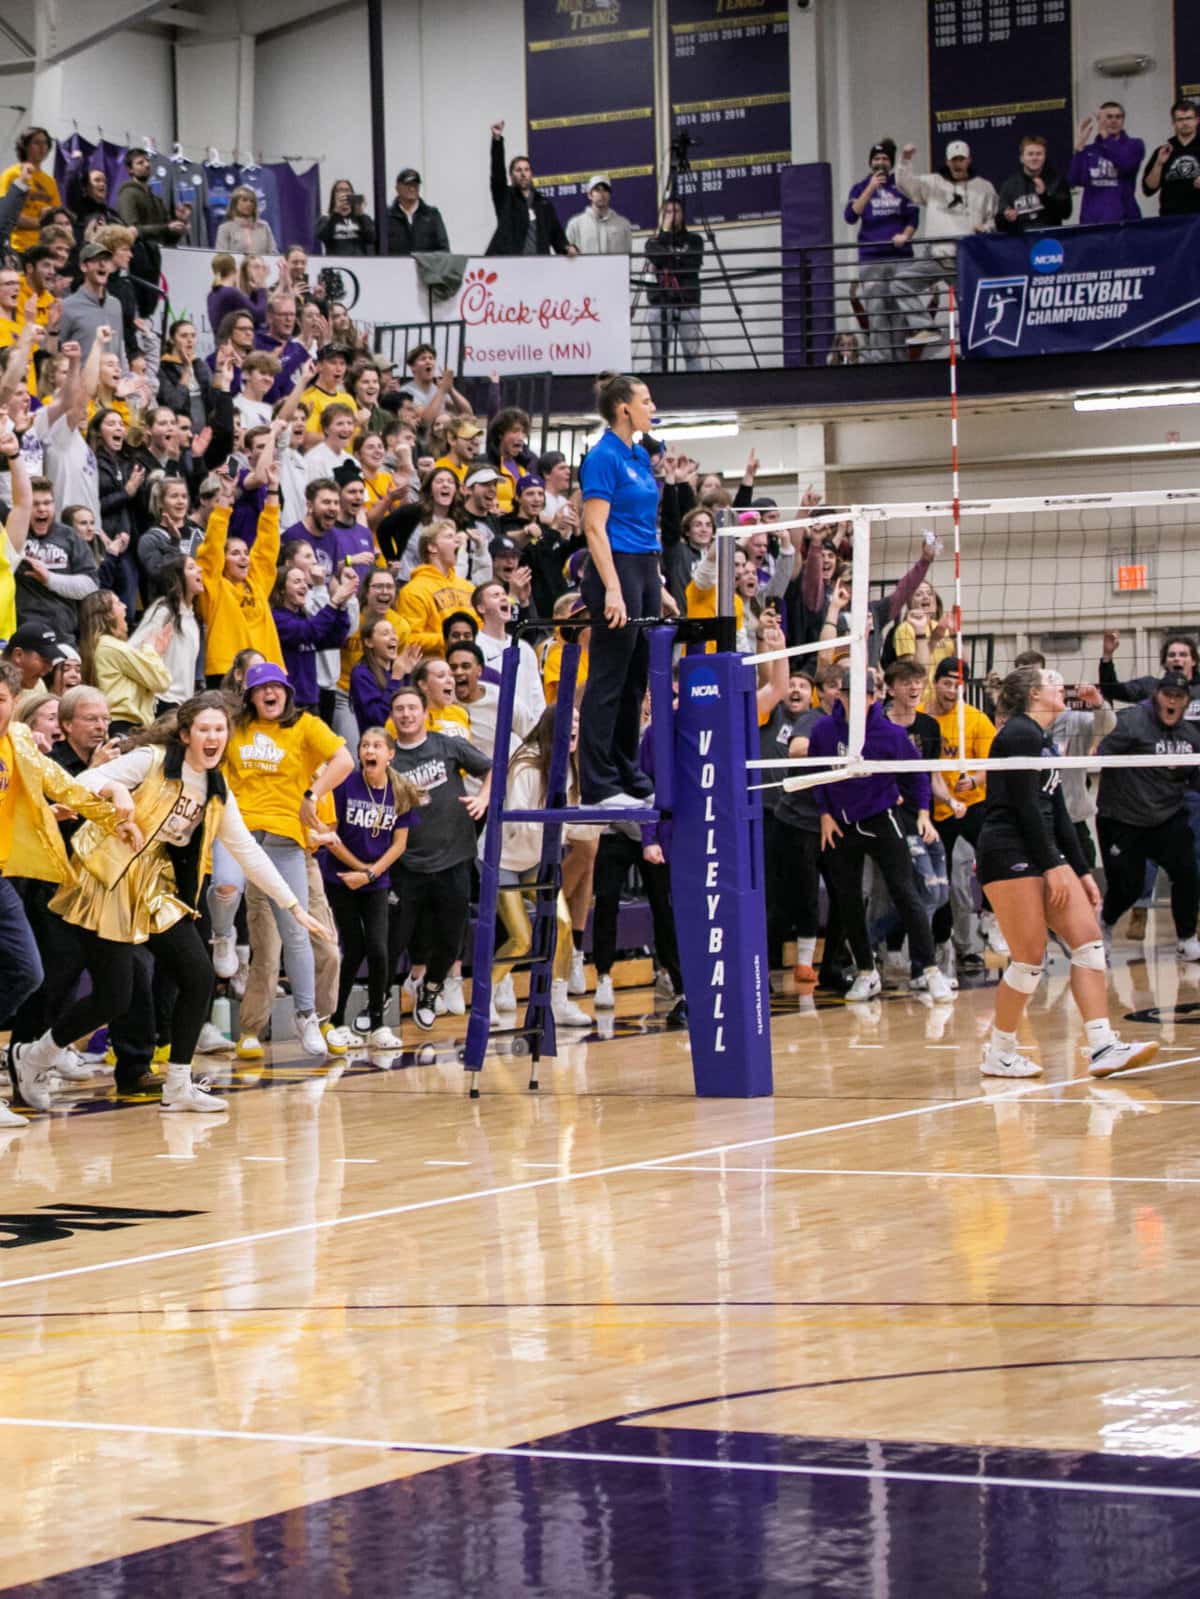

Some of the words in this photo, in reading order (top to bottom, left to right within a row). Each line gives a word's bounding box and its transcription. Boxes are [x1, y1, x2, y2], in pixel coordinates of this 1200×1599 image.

[1033, 254, 1064, 265] NCAA
[1031, 275, 1056, 287] 2022
[1056, 271, 1098, 285] DIVISION
[1114, 266, 1156, 279] WOMEN'S
[1029, 279, 1144, 309] VOLLEYBALL
[1027, 303, 1128, 326] CHAMPIONSHIP
[464, 344, 544, 363] Roseville
[550, 341, 592, 362] (MN)
[691, 684, 720, 697] NCAA
[239, 745, 286, 764] UNW
[243, 761, 279, 774] TENNIS
[700, 730, 726, 1052] VOLLEYBALL
[753, 954, 762, 991] sports
